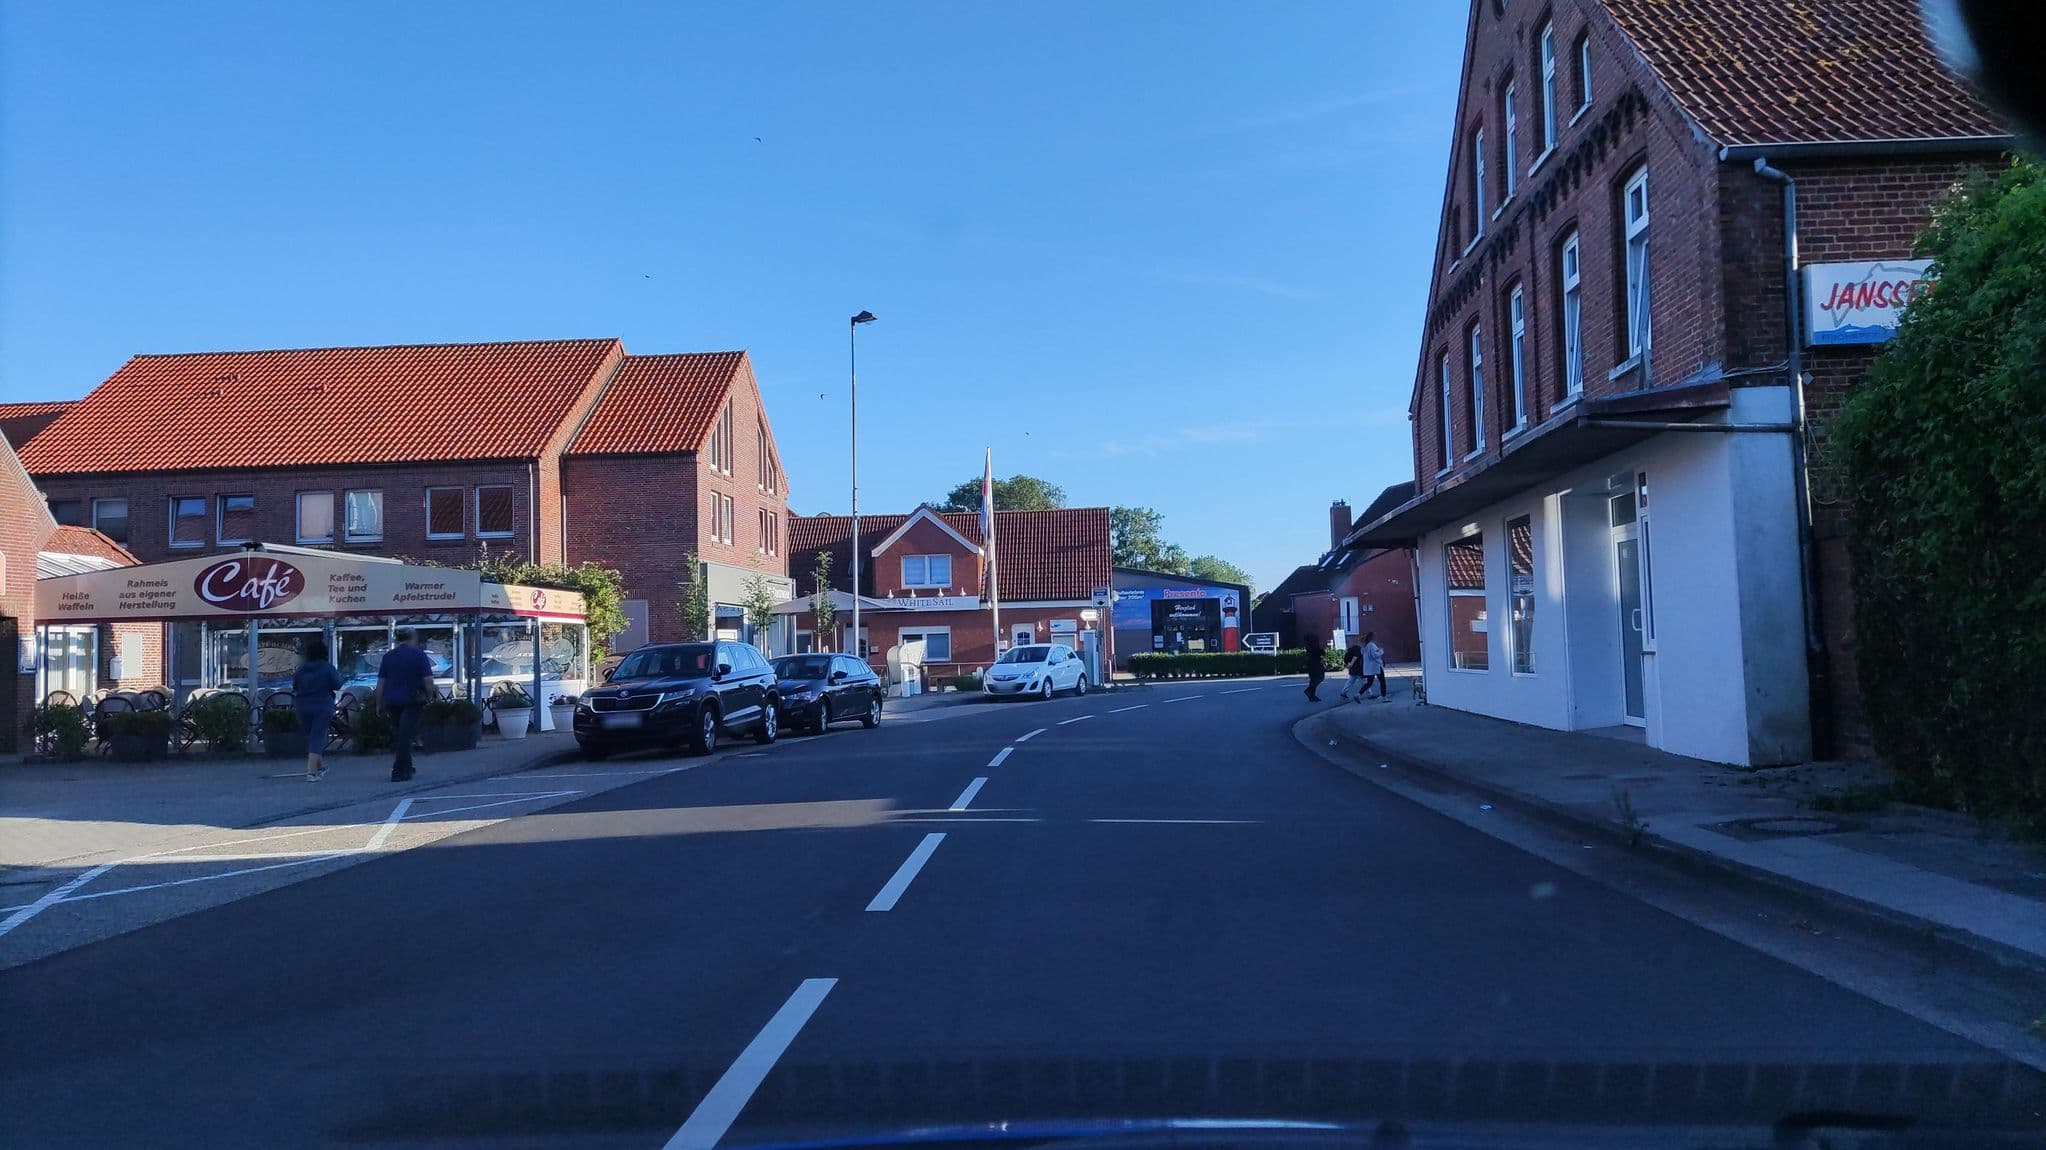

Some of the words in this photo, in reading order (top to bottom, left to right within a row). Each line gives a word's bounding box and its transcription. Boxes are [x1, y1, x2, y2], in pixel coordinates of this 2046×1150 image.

[329, 573, 366, 582] Kaffee,
[127, 579, 169, 588] Rahmeis
[202, 562, 295, 609] Café
[328, 584, 346, 592] Tee
[347, 583, 368, 592] und
[404, 582, 445, 590] Warmer
[62, 591, 90, 600] Heiße
[119, 591, 137, 599] aus
[138, 590, 177, 600] eigener
[328, 594, 366, 603] Kuchen
[392, 591, 456, 602] Apfelstrudel
[58, 602, 94, 611] Waffeln
[119, 601, 177, 610] Herstellung
